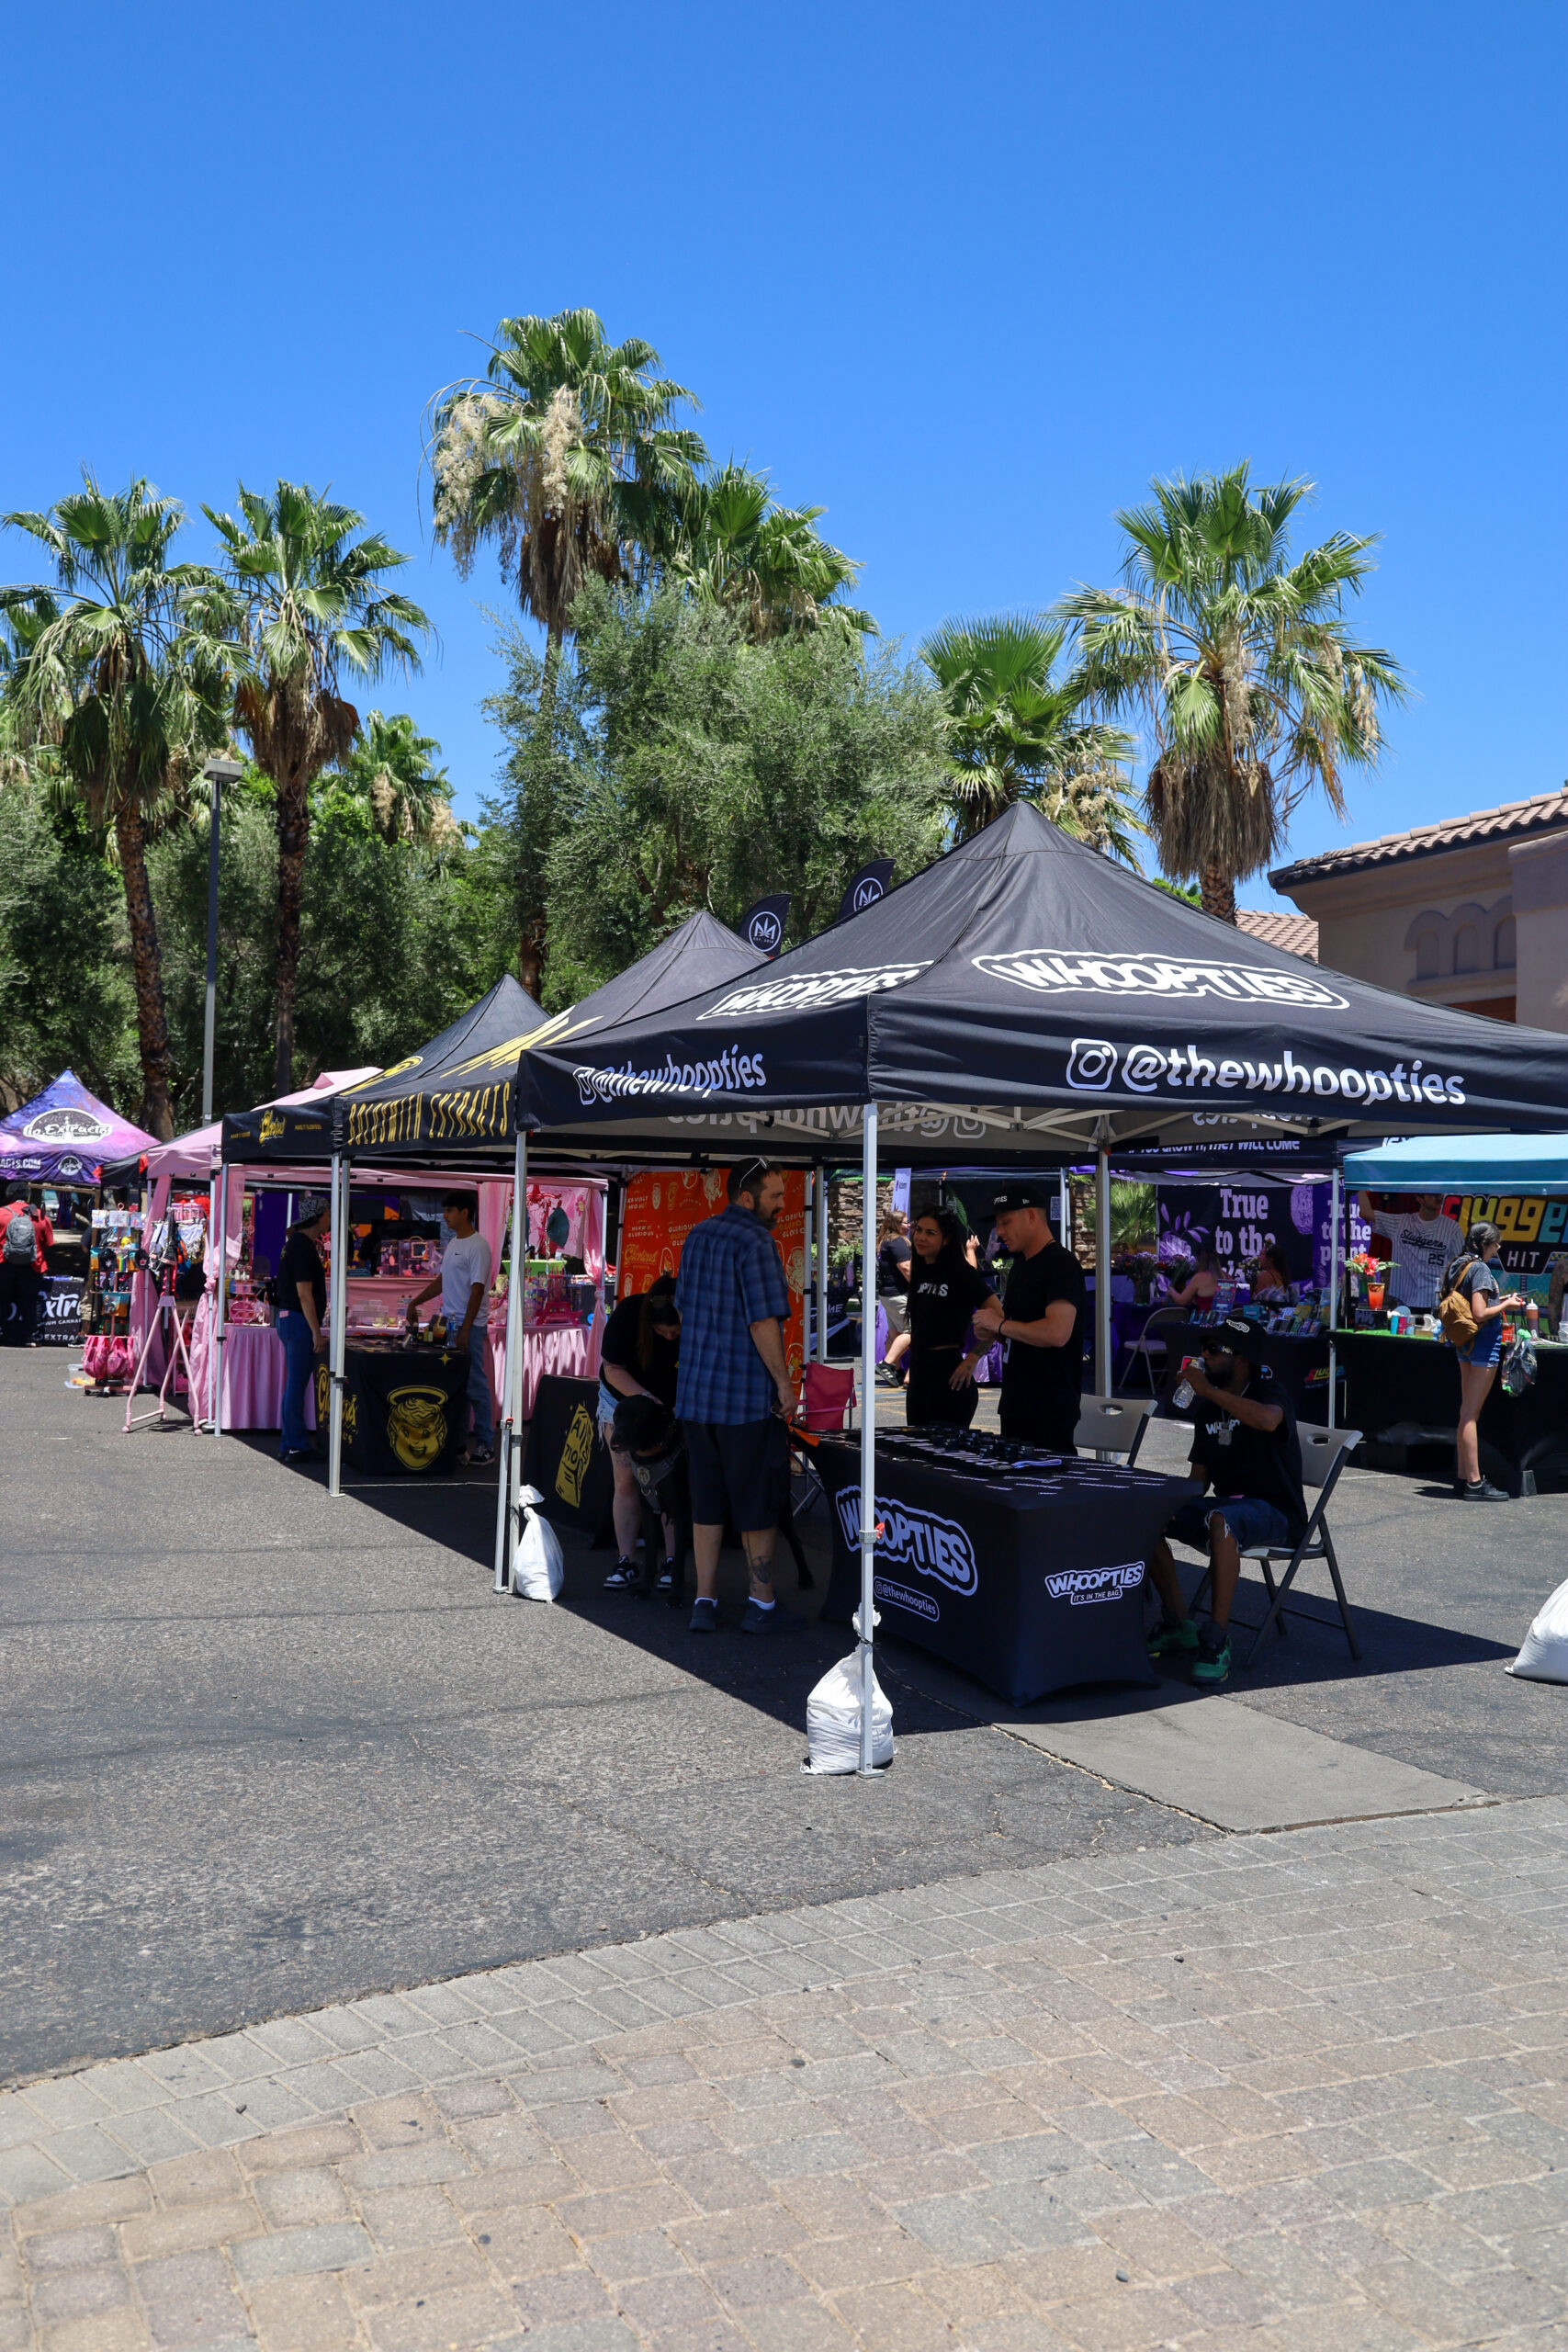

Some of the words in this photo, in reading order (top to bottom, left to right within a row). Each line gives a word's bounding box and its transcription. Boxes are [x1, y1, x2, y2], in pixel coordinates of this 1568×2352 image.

[711, 969, 920, 1015] WHOOPTIES
[991, 957, 1334, 1003] WHOOPTIES
[591, 1044, 767, 1103] @thewhoopties
[1121, 1044, 1467, 1106] @thewhoopties
[348, 1091, 424, 1147] GOLDSMITH
[428, 1081, 511, 1139] EXTRACTS
[0, 1158, 41, 1170] ACTS.COM
[1220, 1188, 1269, 1220] True
[1215, 1225, 1234, 1255] to
[1342, 1220, 1371, 1241] he
[1401, 1228, 1448, 1250] Sluggers
[1319, 1243, 1367, 1266] pant
[1427, 1252, 1445, 1267] 25
[1506, 1250, 1541, 1269] HIT
[840, 1498, 971, 1584] WOPTIES
[1048, 1565, 1143, 1595] WHOOPTIES
[882, 1583, 936, 1615] @thewhoopties
[1073, 1594, 1085, 1602] IT'S
[1107, 1589, 1121, 1598] BAG.
